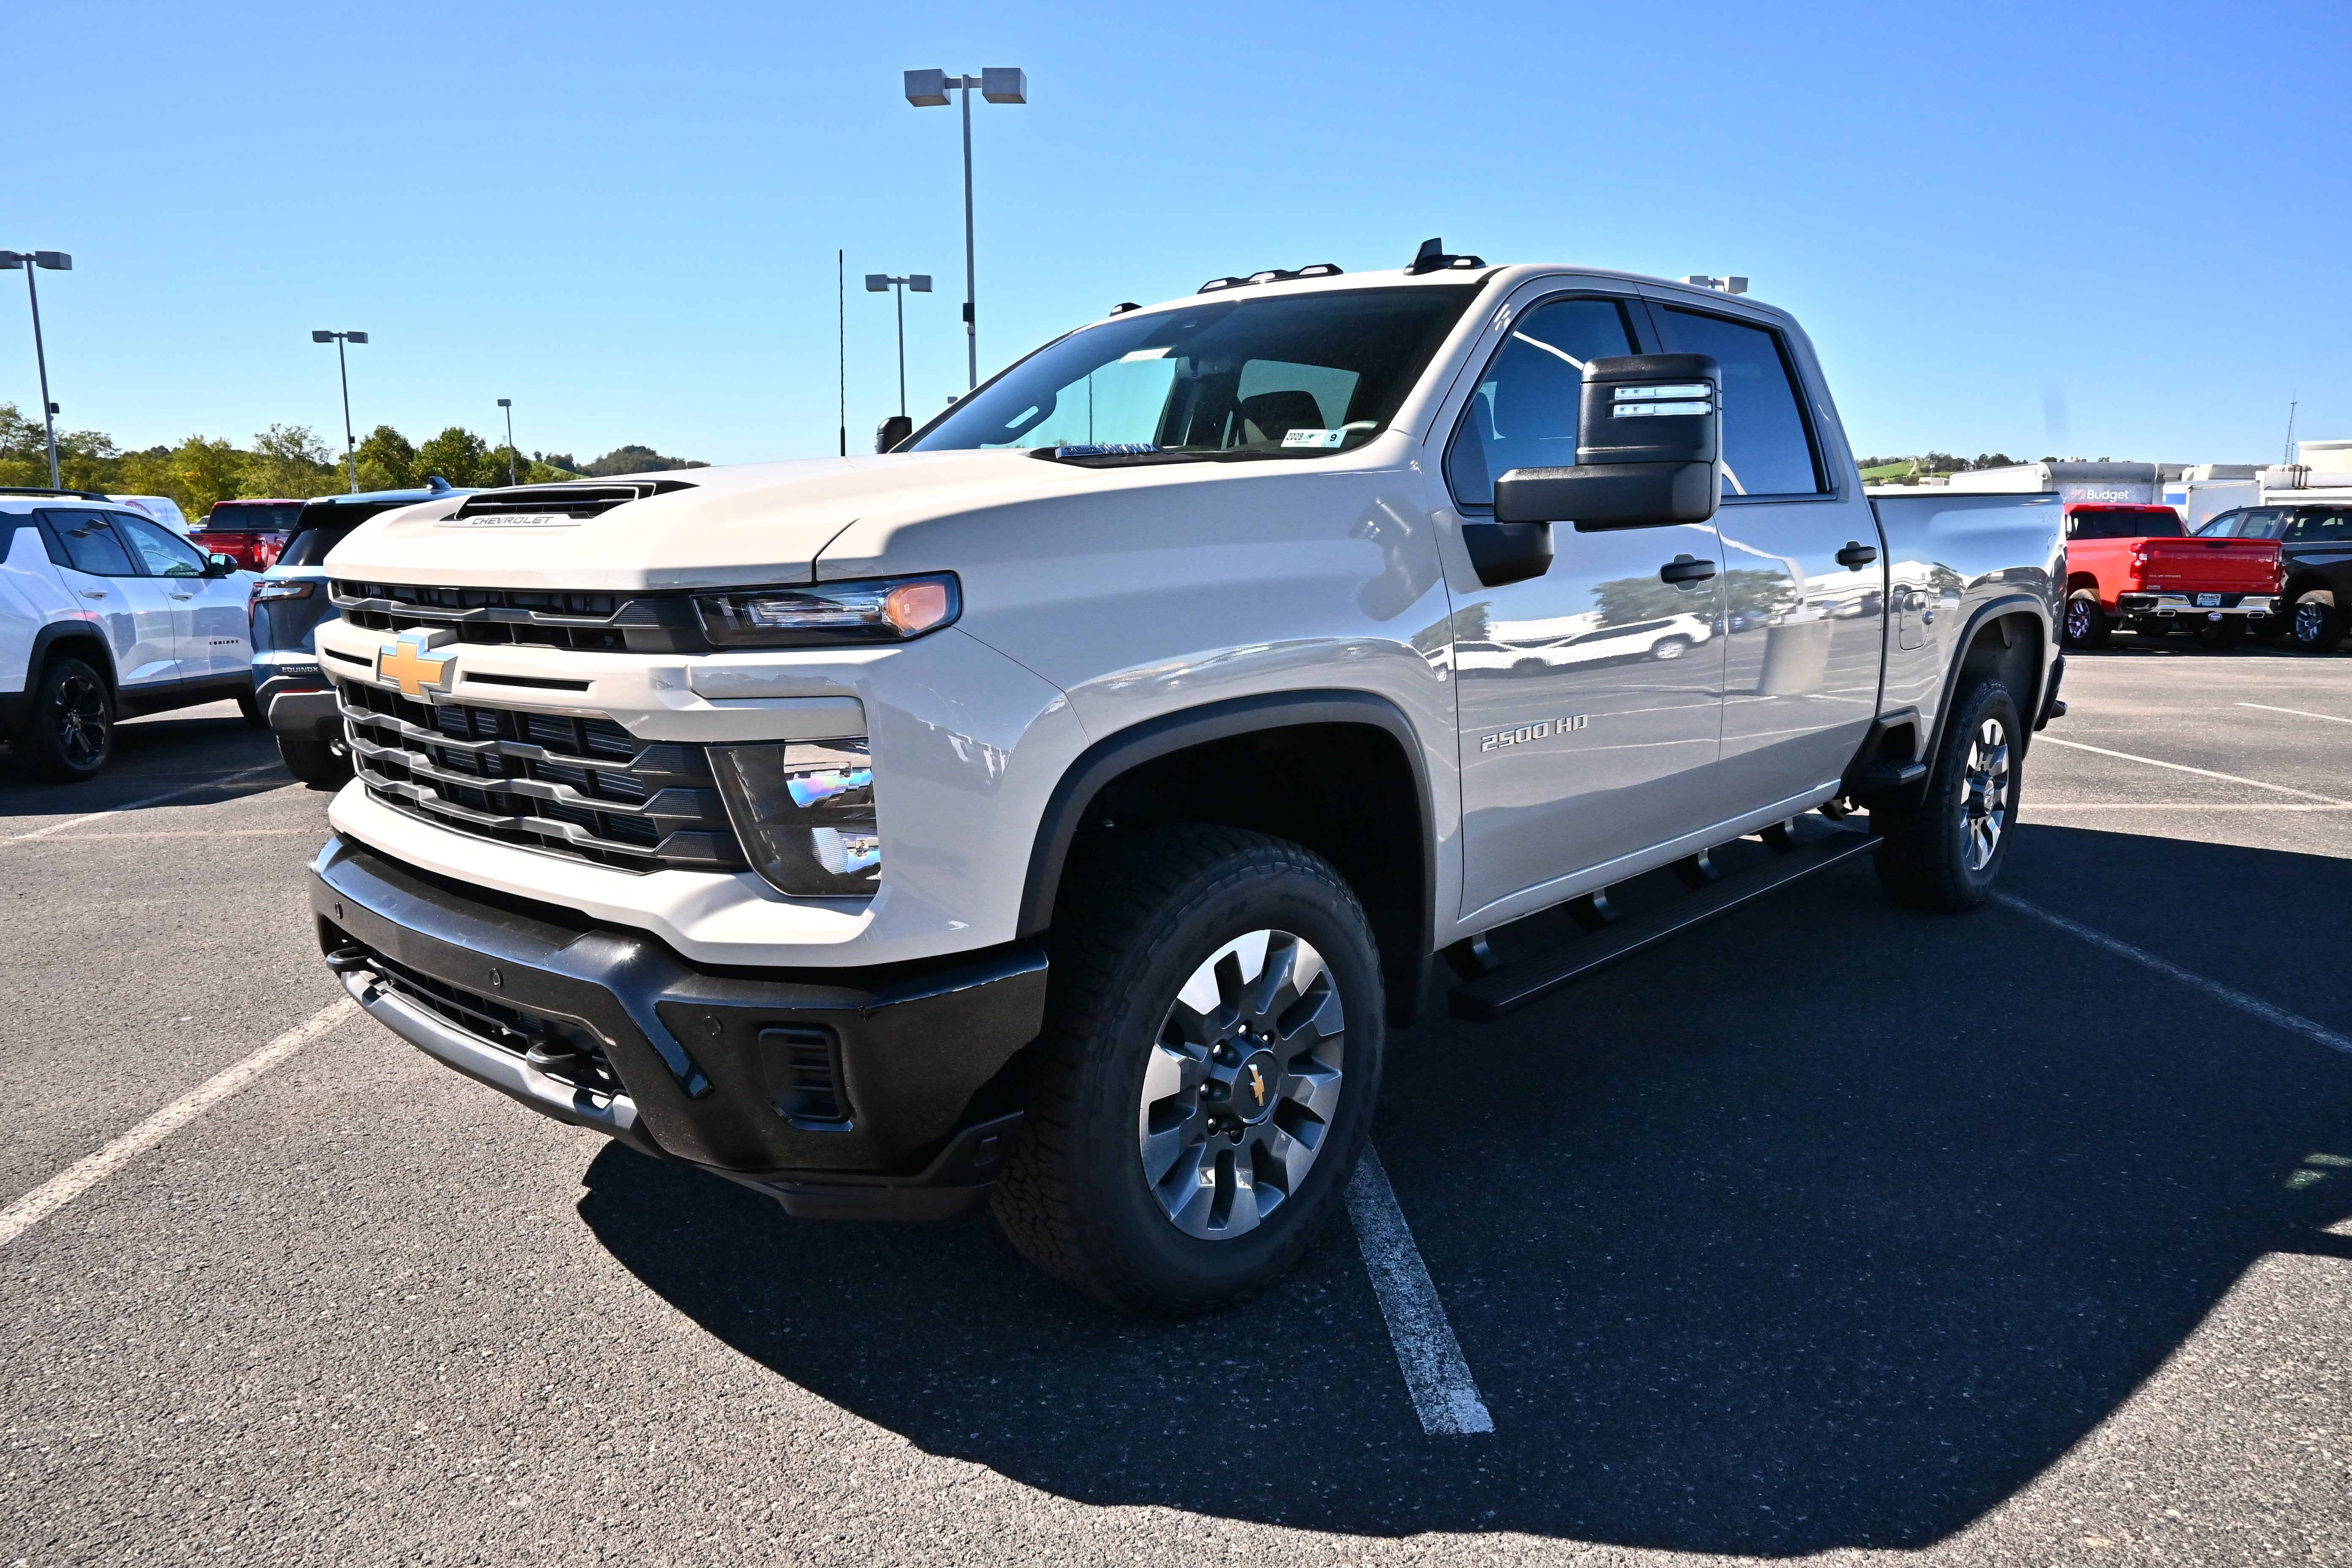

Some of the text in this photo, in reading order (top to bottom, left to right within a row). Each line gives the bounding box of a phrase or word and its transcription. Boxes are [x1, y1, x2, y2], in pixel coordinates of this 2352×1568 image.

[2087, 489, 2129, 503] Budget
[472, 517, 555, 525] CHEVROLET
[1481, 713, 1588, 753] 2500 HD
